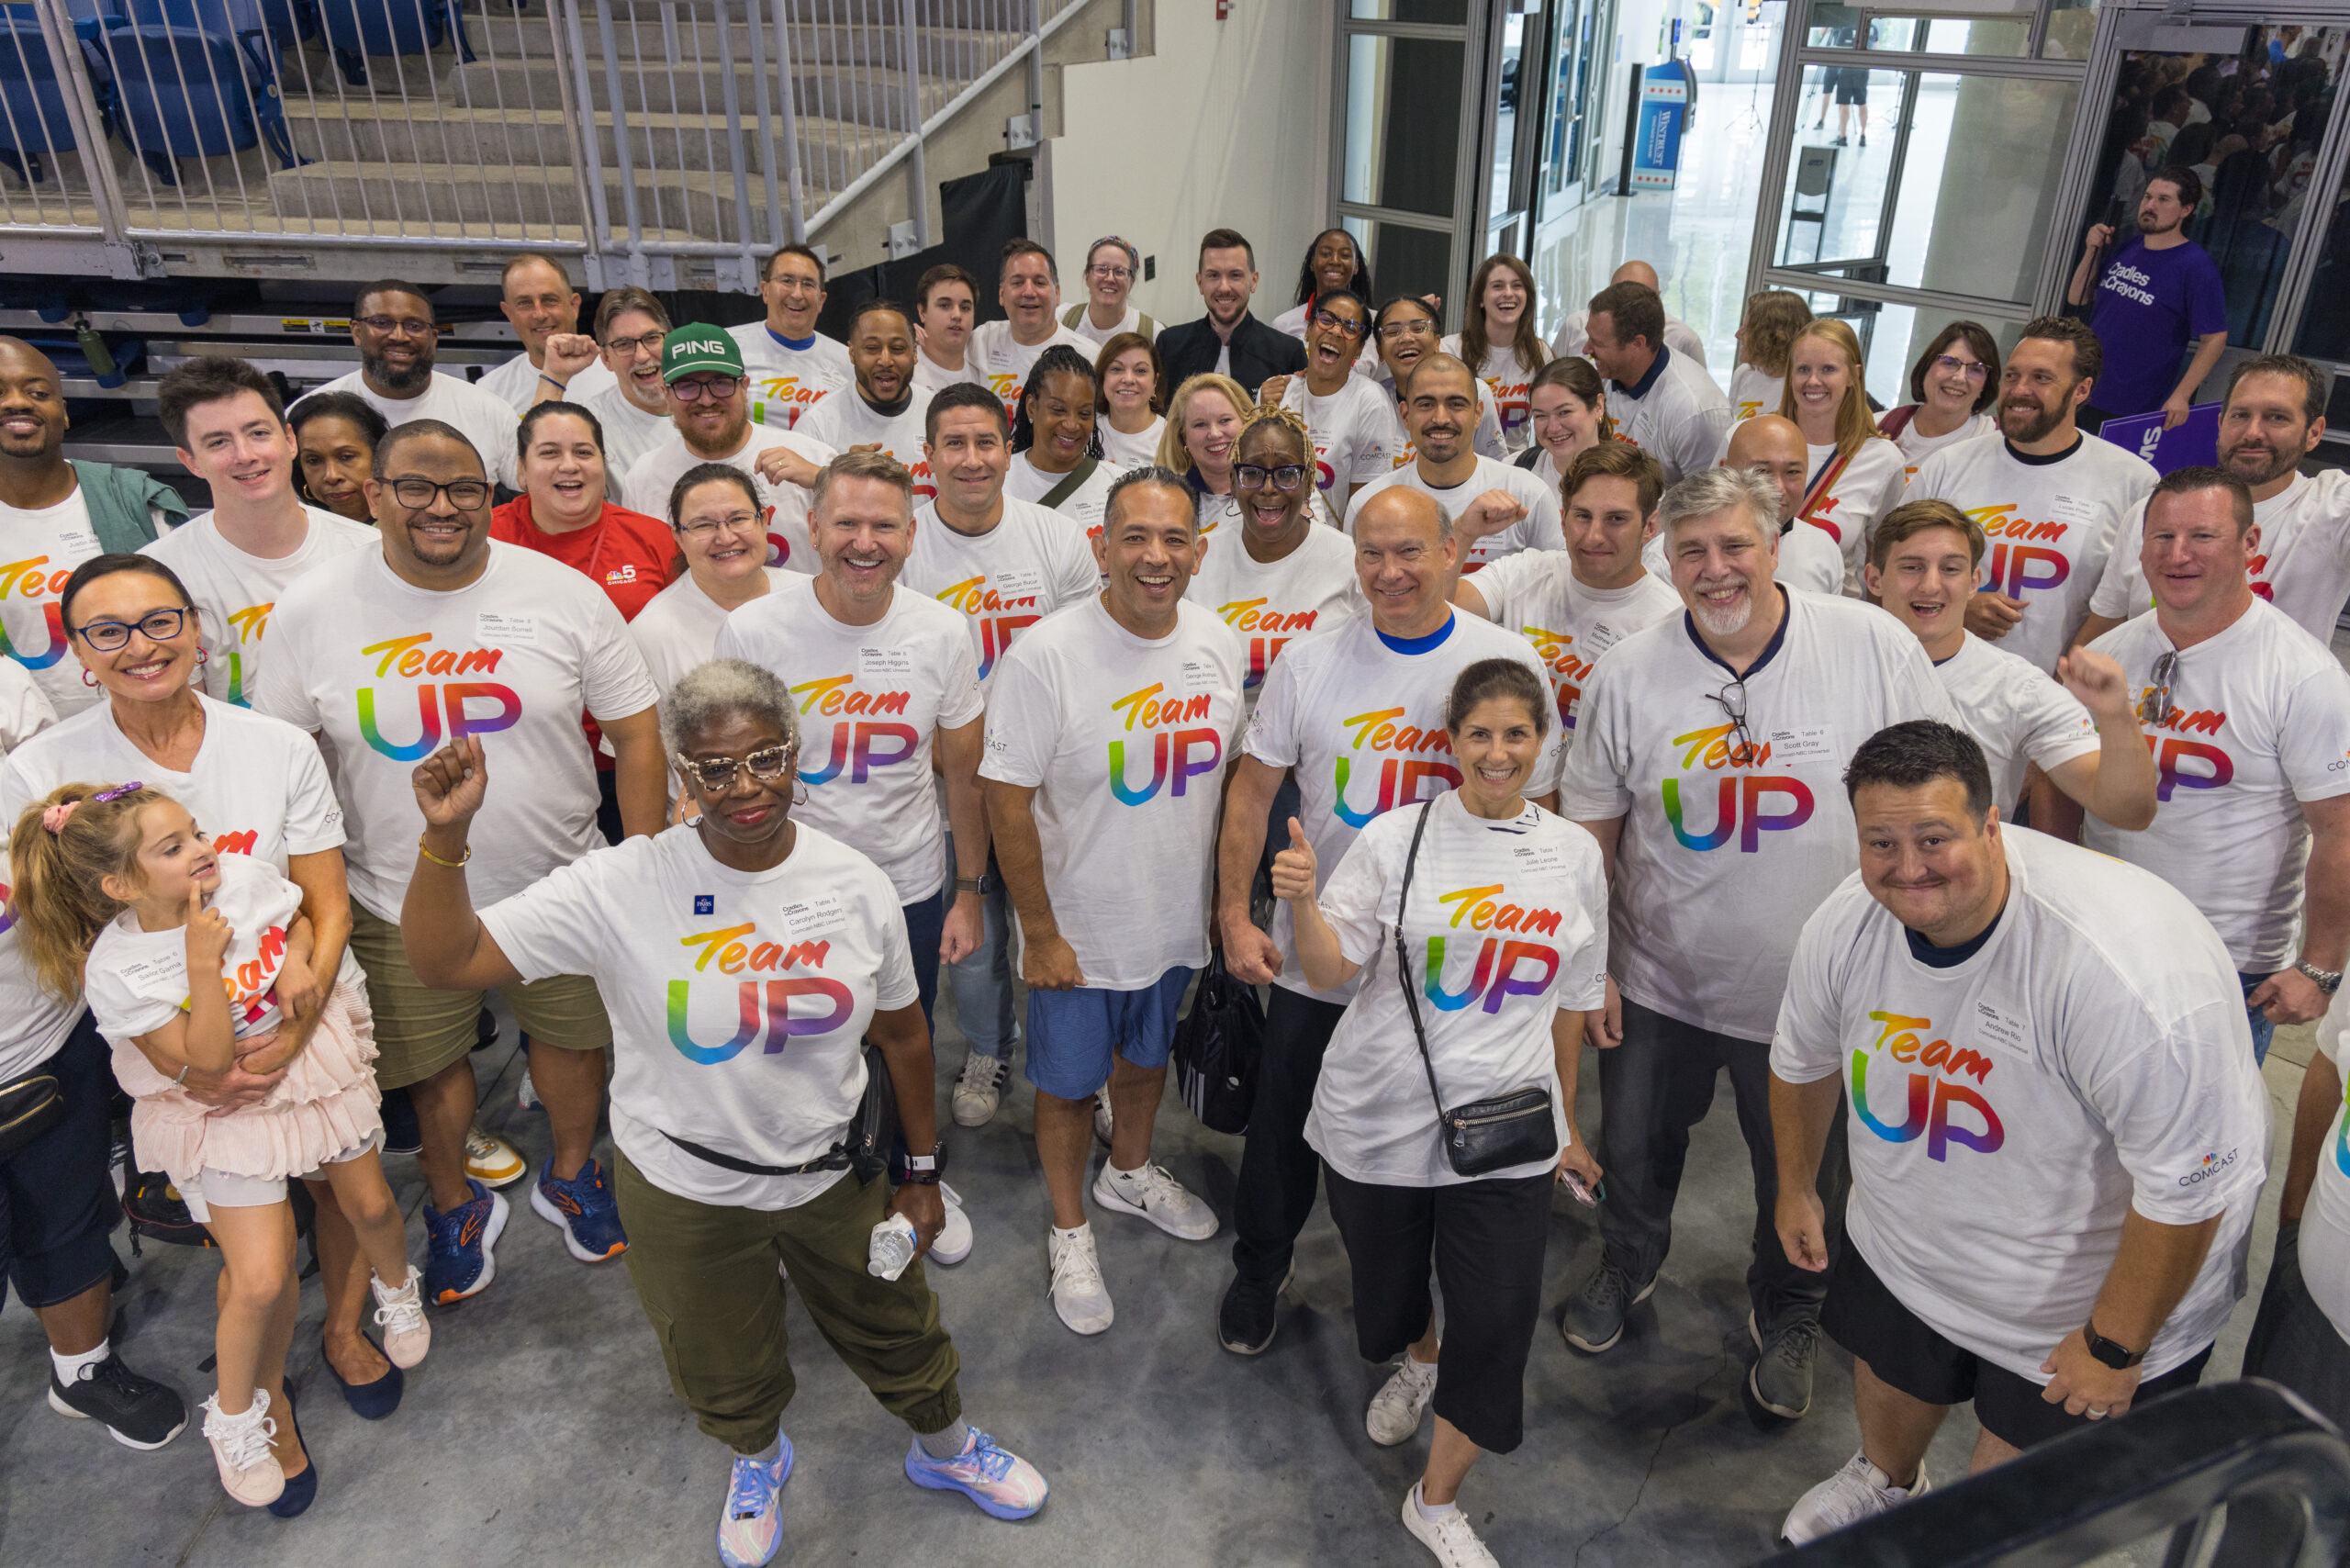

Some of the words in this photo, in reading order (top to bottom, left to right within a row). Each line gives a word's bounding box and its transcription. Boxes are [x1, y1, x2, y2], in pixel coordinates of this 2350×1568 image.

[1655, 110, 1671, 166] WINTRUST
[2106, 275, 2154, 305] Crayons
[2109, 262, 2150, 286] Cadles
[672, 341, 725, 359] PING
[989, 375, 1024, 400] Tea
[1360, 453, 1391, 461] COMCAST
[1964, 504, 2068, 543] Team
[0, 554, 74, 599] Tea
[622, 565, 636, 579] 5
[1217, 597, 1317, 632] Team
[362, 632, 503, 678] Team
[789, 674, 911, 716] Team
[1112, 682, 1211, 732] Team
[356, 682, 522, 761] UP
[1343, 707, 1453, 756] Team
[797, 722, 919, 786] UP
[1108, 728, 1221, 806] UP
[2146, 734, 2234, 802] P
[1333, 756, 1465, 829] UP
[1662, 776, 1815, 854] UP
[782, 903, 803, 913] Cradles
[788, 907, 810, 916] Crayons
[789, 914, 816, 925] Carolyn
[815, 899, 831, 907] Table
[1438, 883, 1562, 937] Team
[159, 962, 182, 974] Gama
[680, 922, 830, 975] Team
[1425, 936, 1560, 1014] UP
[667, 977, 855, 1065] UP
[1986, 1021, 2009, 1036] Andrew
[2010, 1031, 2020, 1042] Rio
[2006, 1017, 2020, 1028] Table
[1869, 1011, 1994, 1085] Team
[1852, 1048, 2005, 1163] UP
[2179, 1148, 2238, 1186] COMCAST
